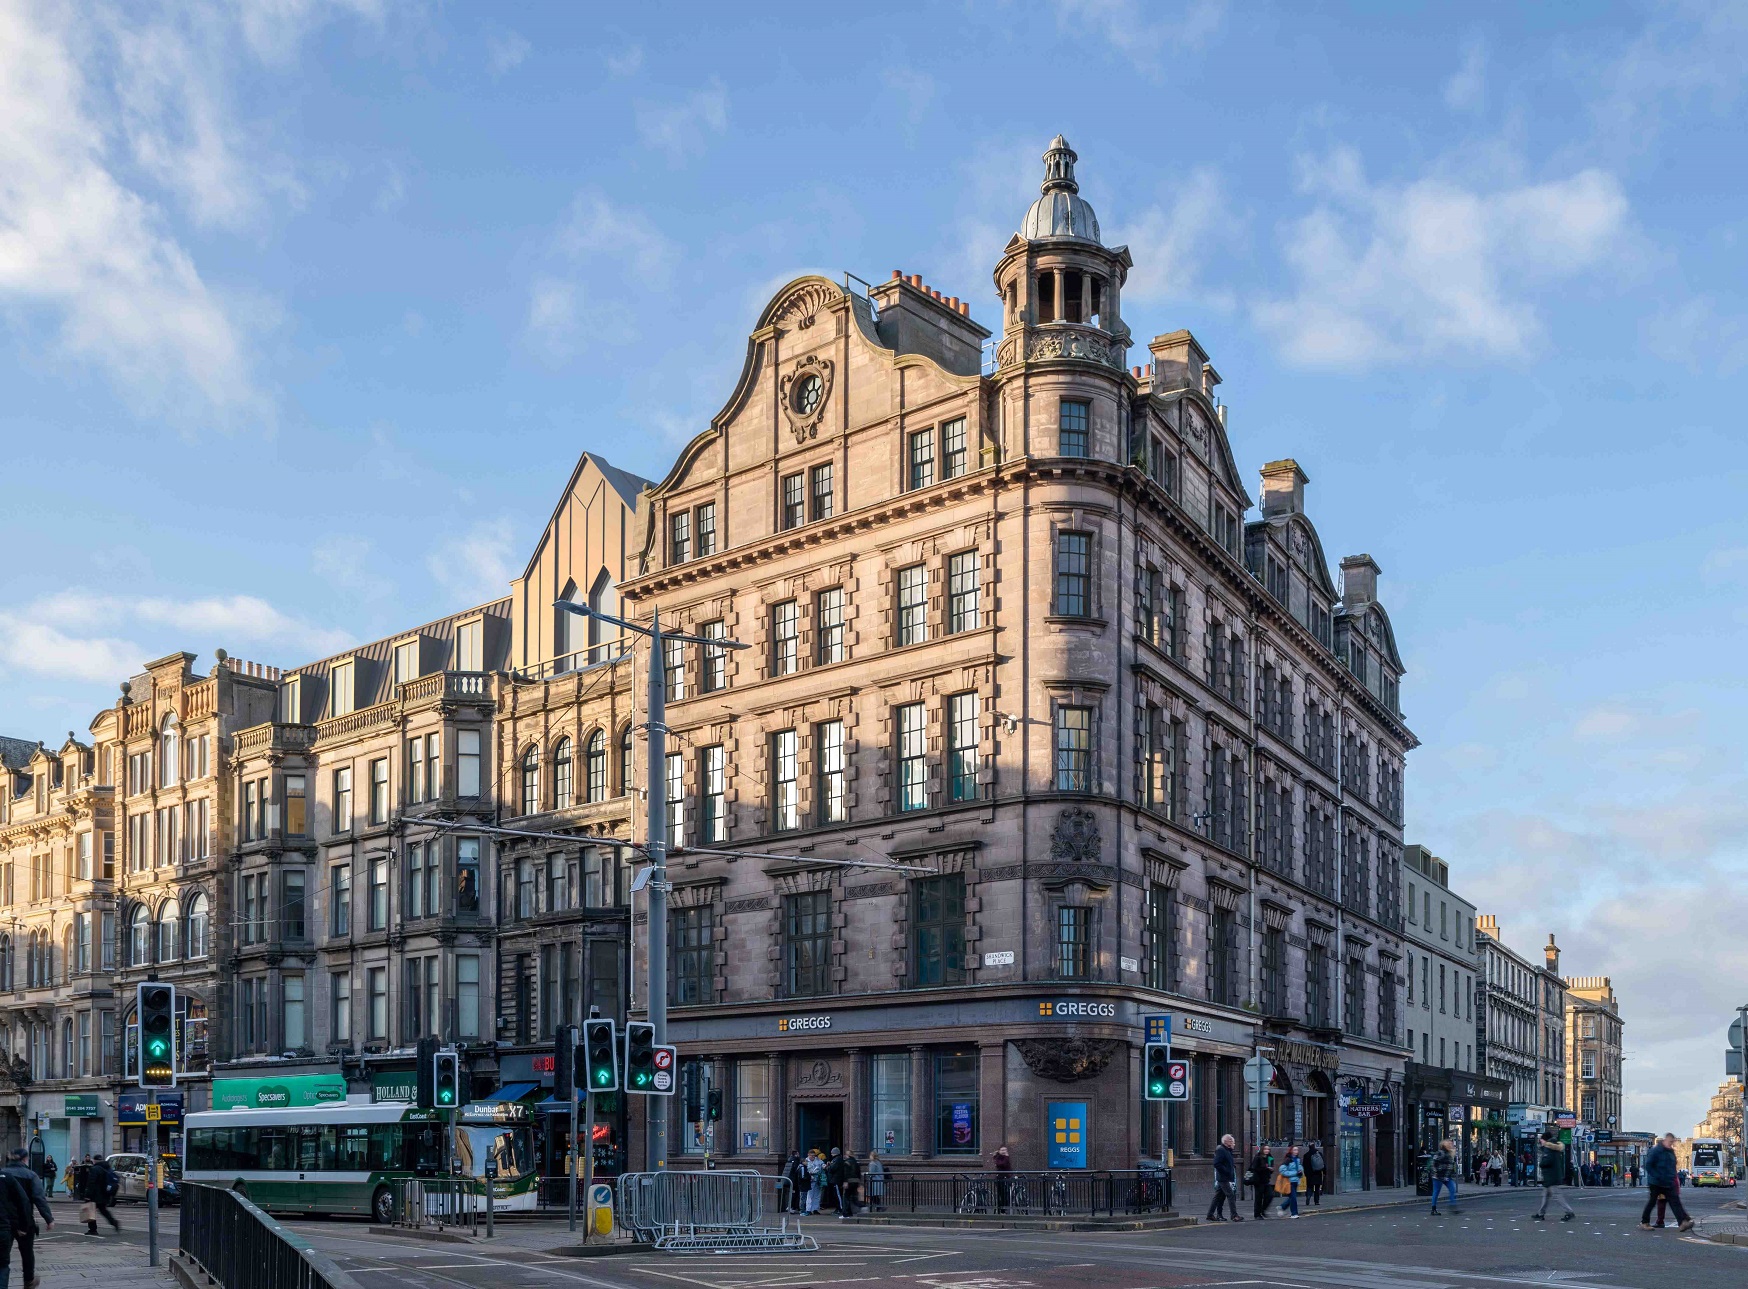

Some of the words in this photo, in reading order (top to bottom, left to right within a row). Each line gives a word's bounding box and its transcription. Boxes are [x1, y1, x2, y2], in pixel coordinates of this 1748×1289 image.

[1056, 1002, 1115, 1016] GREGGS
[788, 1016, 831, 1030] GREGGS
[1191, 1019, 1212, 1033] GREGGS
[258, 1092, 285, 1103] Specsavers
[376, 1086, 410, 1100] HOLLAND
[474, 1105, 498, 1113] Dunbar
[509, 1105, 523, 1117] X7
